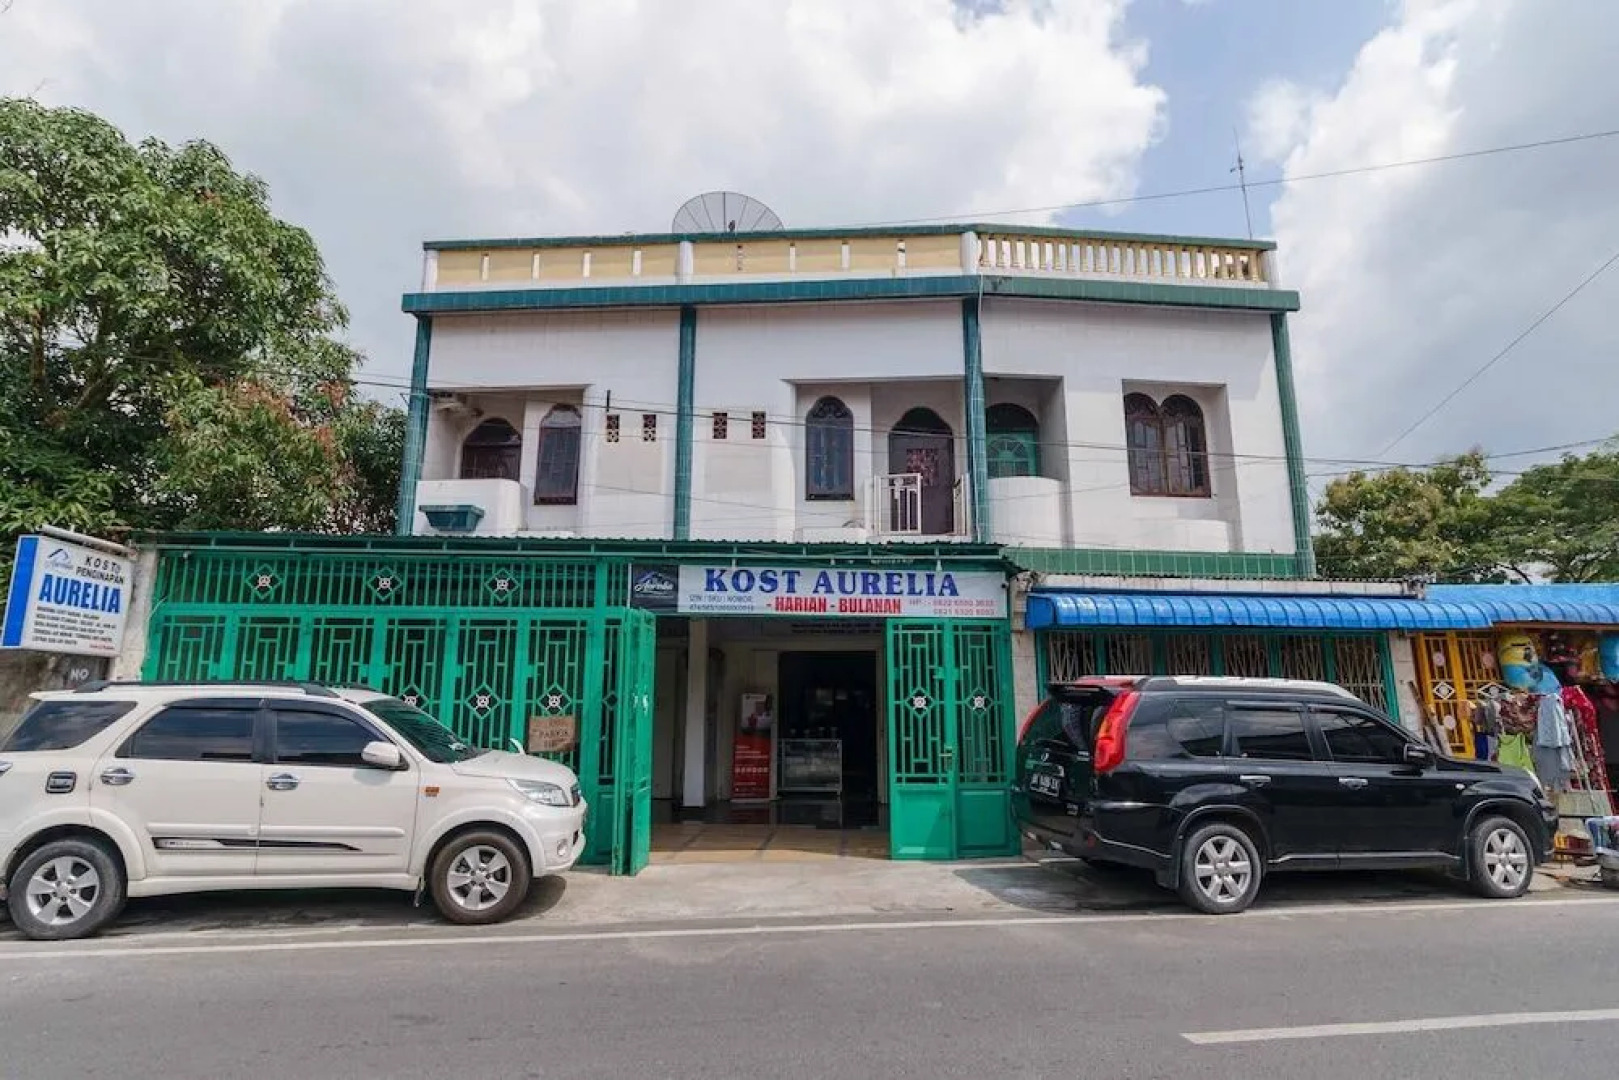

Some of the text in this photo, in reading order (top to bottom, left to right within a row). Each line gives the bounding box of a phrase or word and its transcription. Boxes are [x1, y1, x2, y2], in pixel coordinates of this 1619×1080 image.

[39, 573, 121, 613] AURELIA
[705, 568, 959, 596] KOST AURELIA
[775, 596, 827, 613] HARIAN
[839, 597, 901, 614] BULANAN
